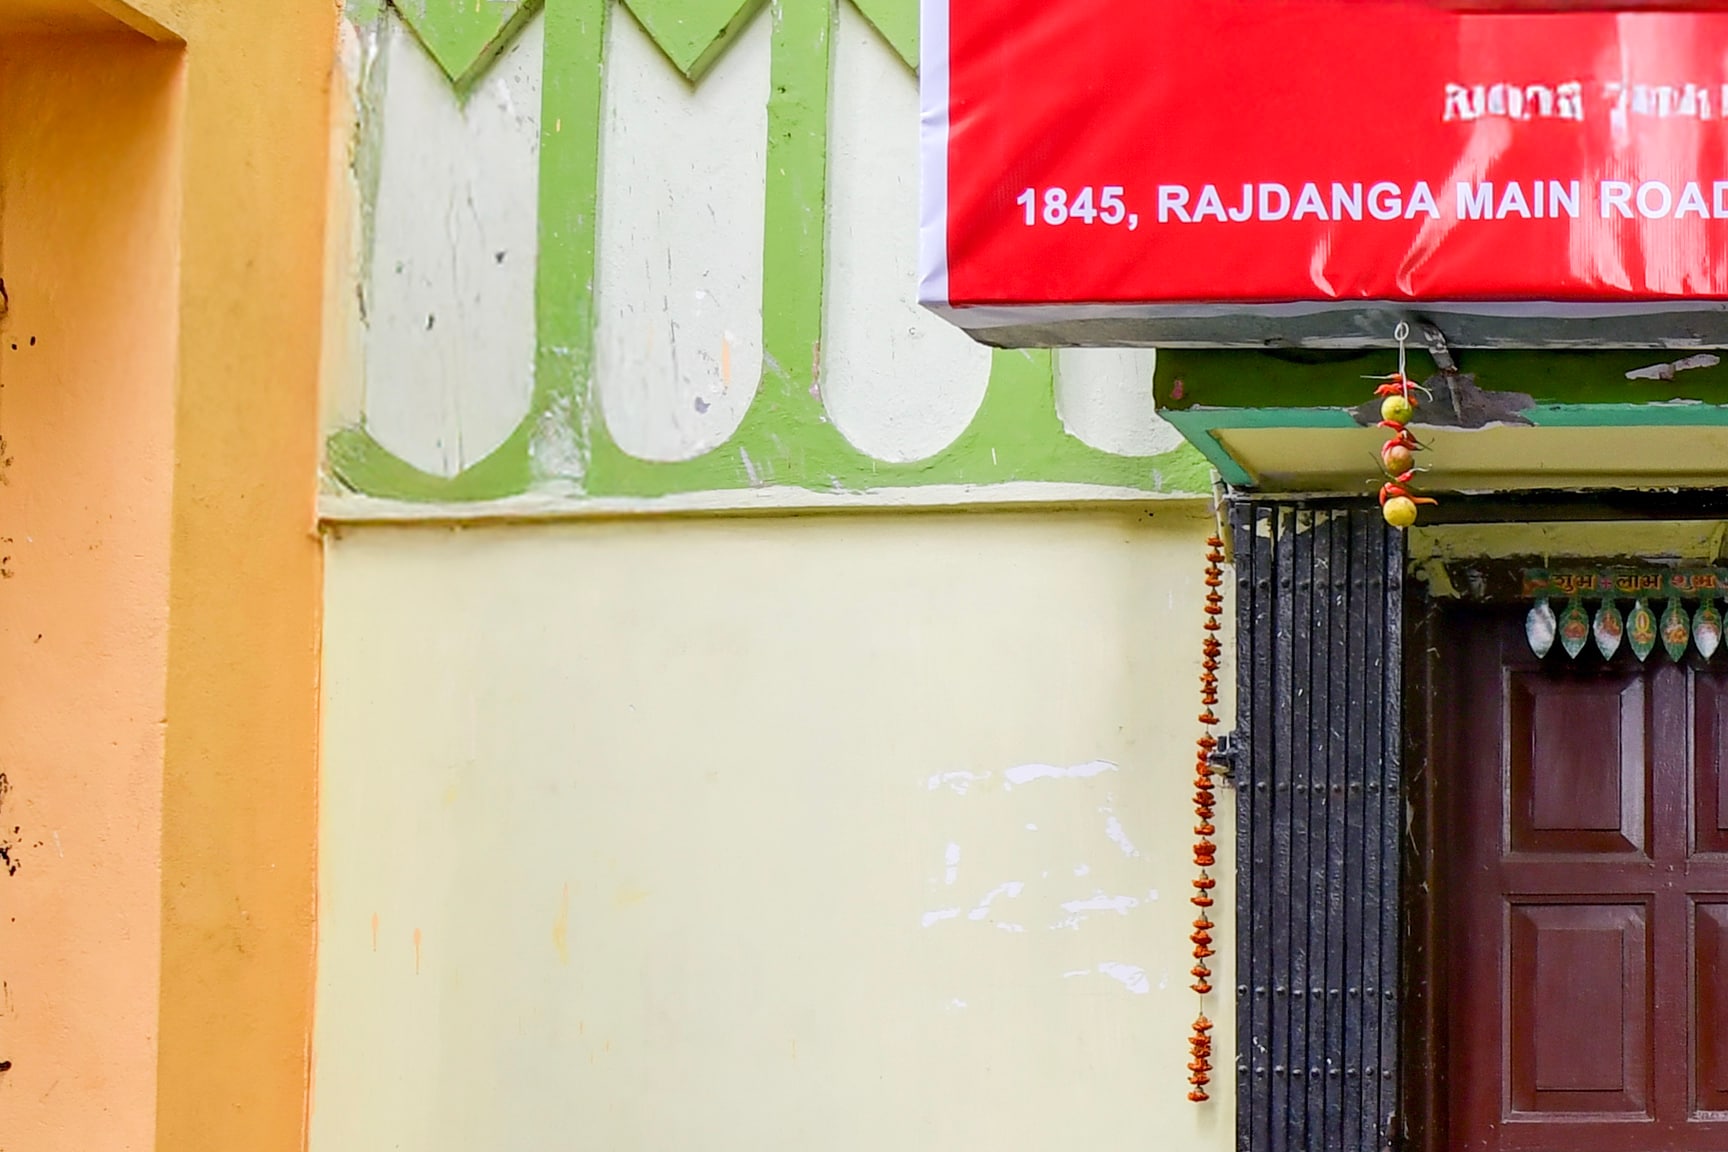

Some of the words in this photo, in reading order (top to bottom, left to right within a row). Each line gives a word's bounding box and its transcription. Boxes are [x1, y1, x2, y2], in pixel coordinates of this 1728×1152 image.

[1016, 186, 1139, 231] 1845,
[1157, 181, 1440, 223] RAJDANGA
[1456, 180, 1580, 220] MAIN
